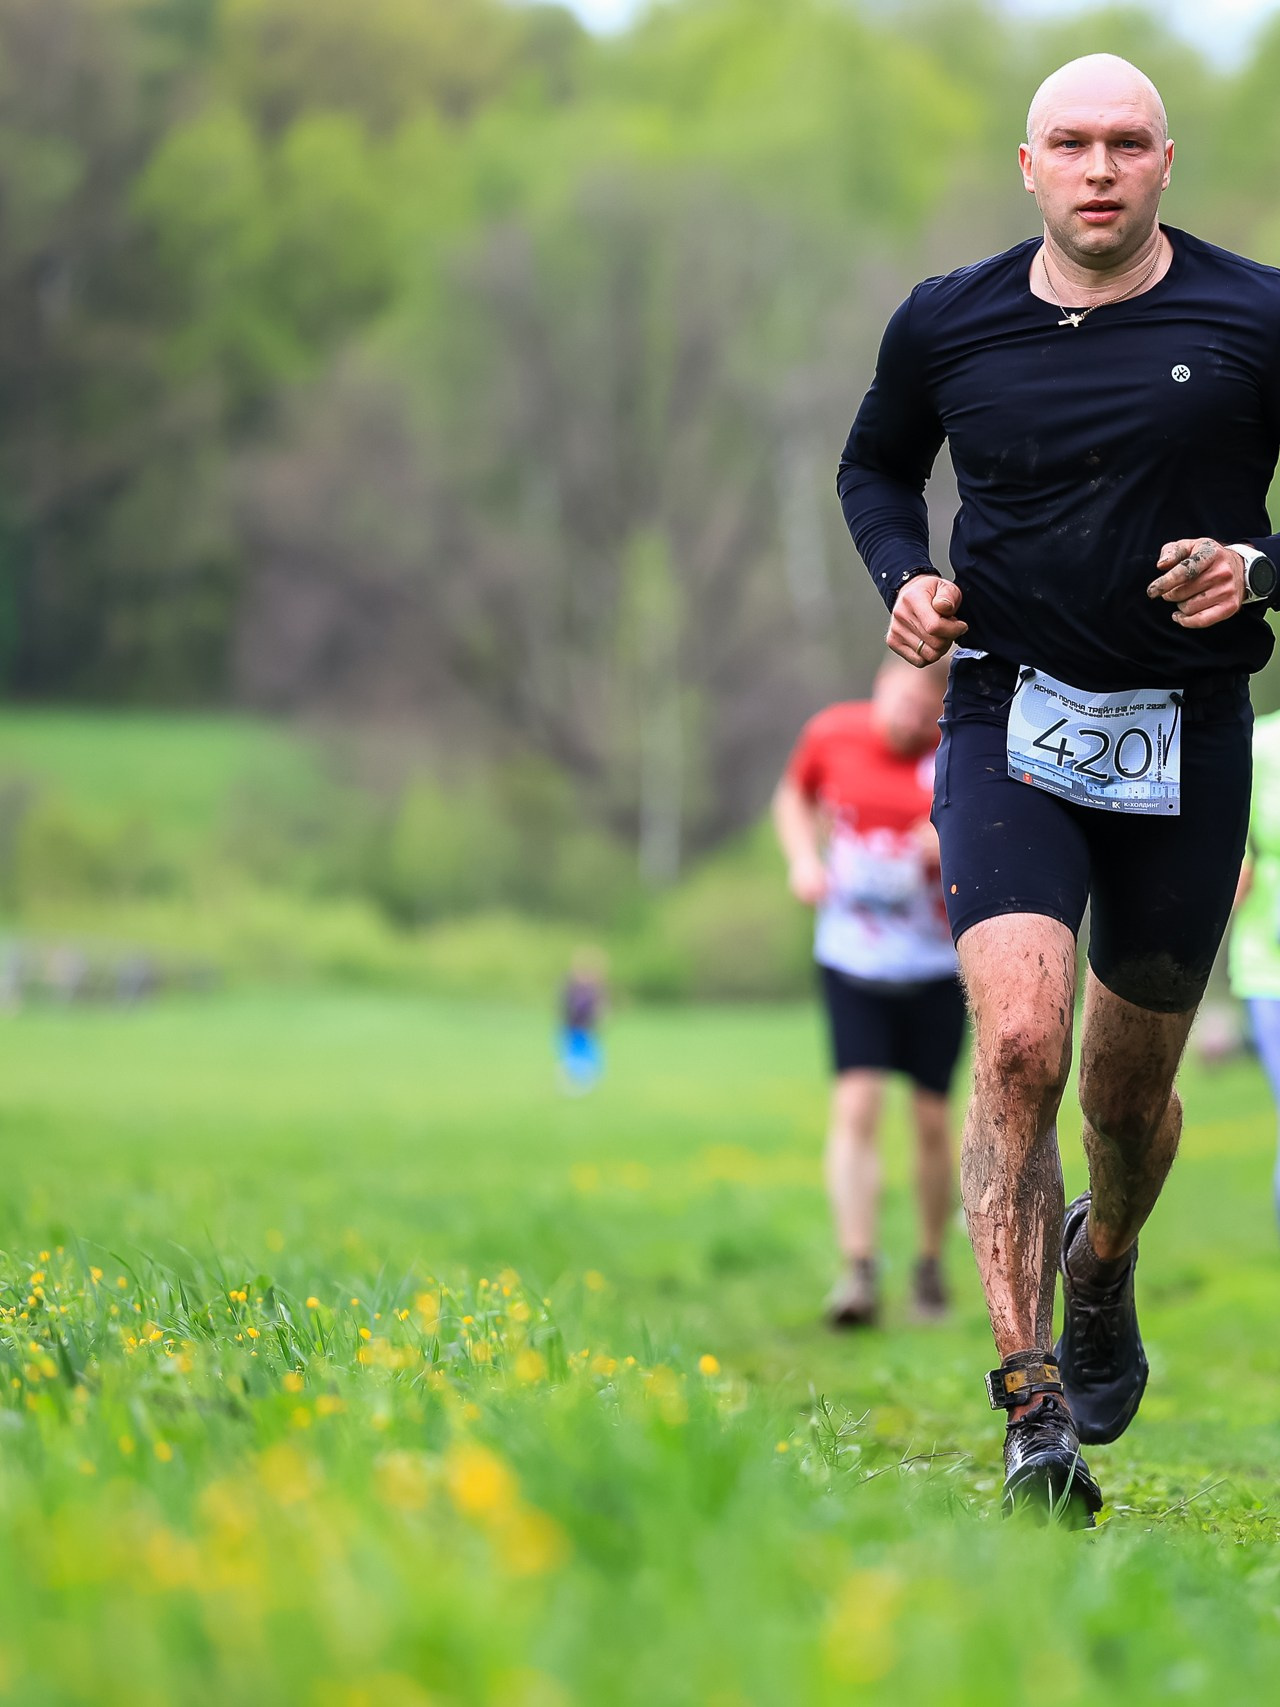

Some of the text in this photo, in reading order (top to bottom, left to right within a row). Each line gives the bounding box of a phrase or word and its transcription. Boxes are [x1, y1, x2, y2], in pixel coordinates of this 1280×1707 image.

[1034, 684, 1058, 698] ЯСНАЯ
[1059, 695, 1086, 711] ПОЛЯНА
[1087, 706, 1114, 714] ТРЕЙЛ
[1032, 717, 1153, 780] 420
